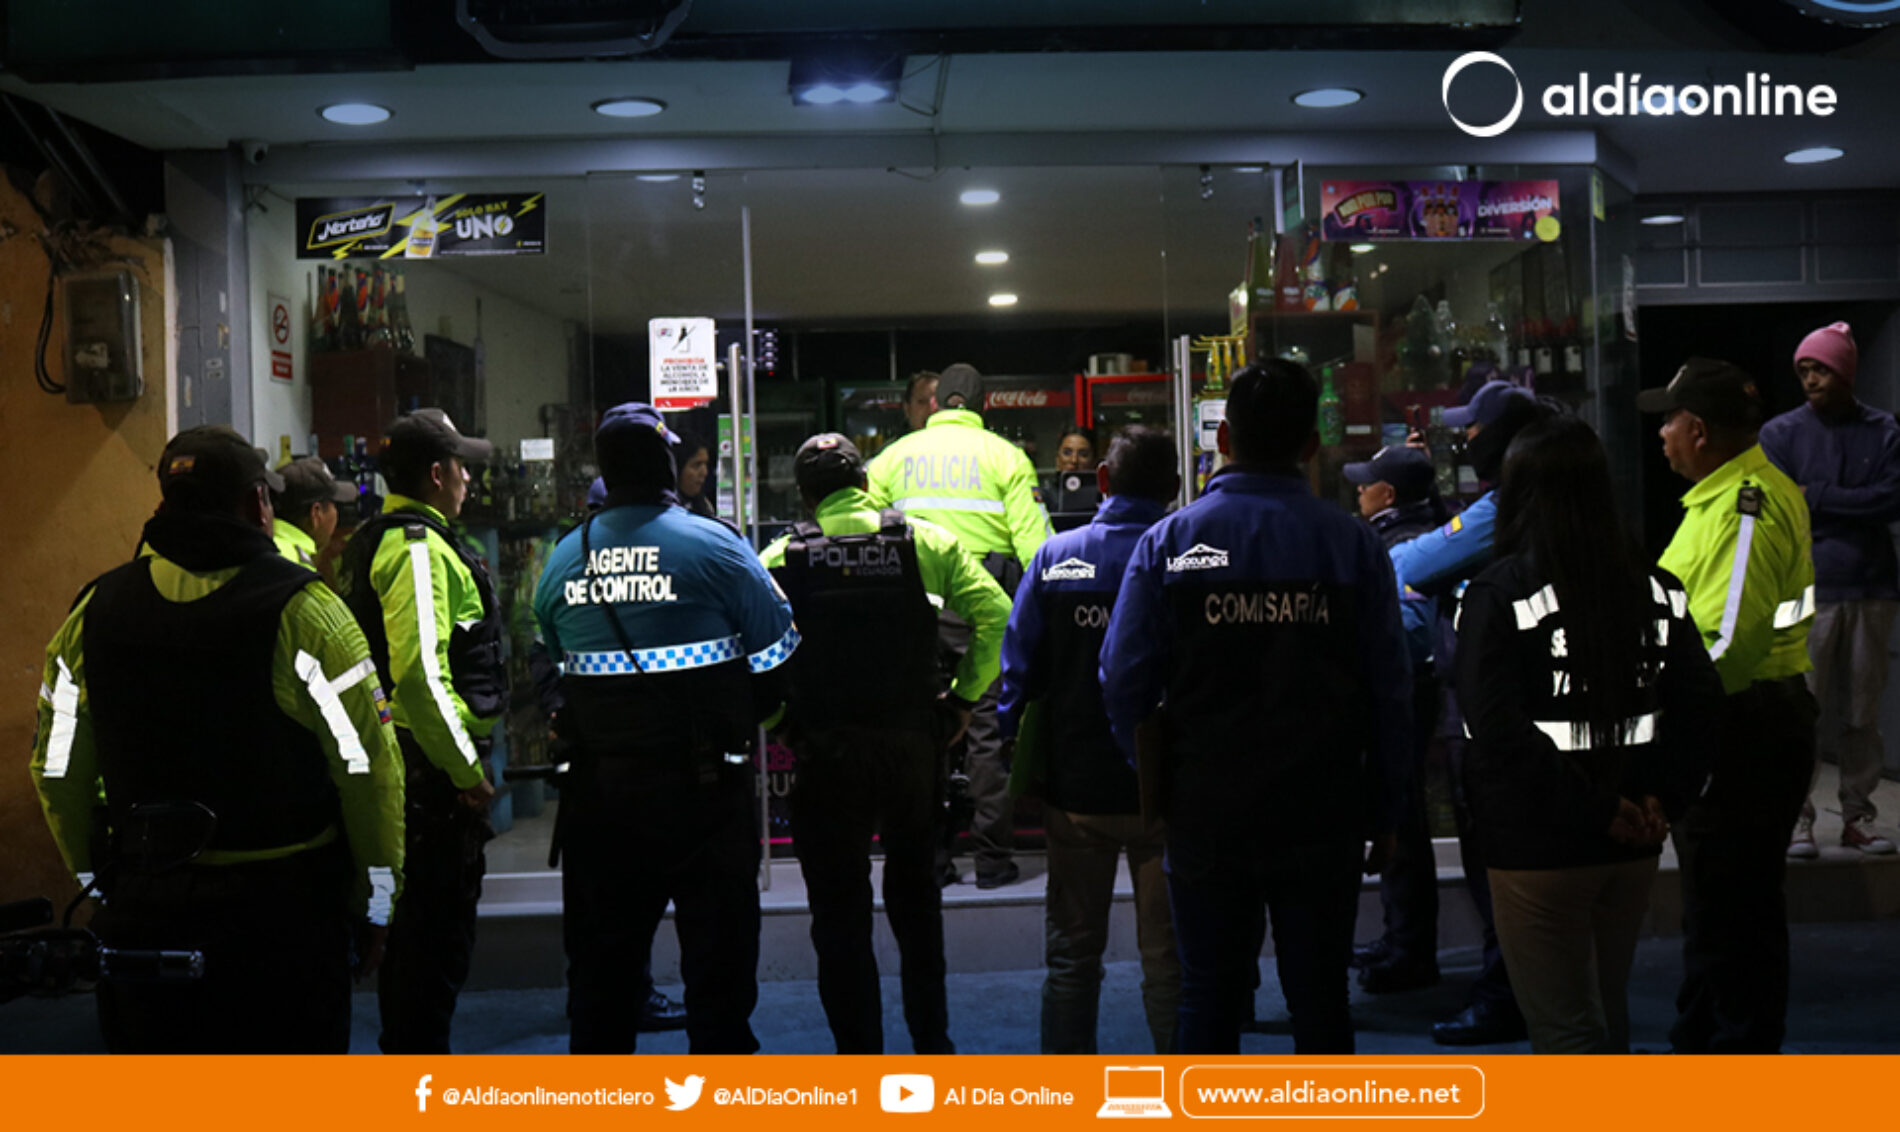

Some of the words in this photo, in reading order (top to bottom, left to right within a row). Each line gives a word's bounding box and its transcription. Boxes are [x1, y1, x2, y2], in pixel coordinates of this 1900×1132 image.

[1478, 195, 1553, 217] DIVERSIÓN
[456, 213, 514, 240] UNO
[585, 545, 660, 576] AGENTE
[564, 579, 589, 606] DE
[590, 573, 678, 605] CONTROL
[1204, 582, 1330, 626] COMISARÍA
